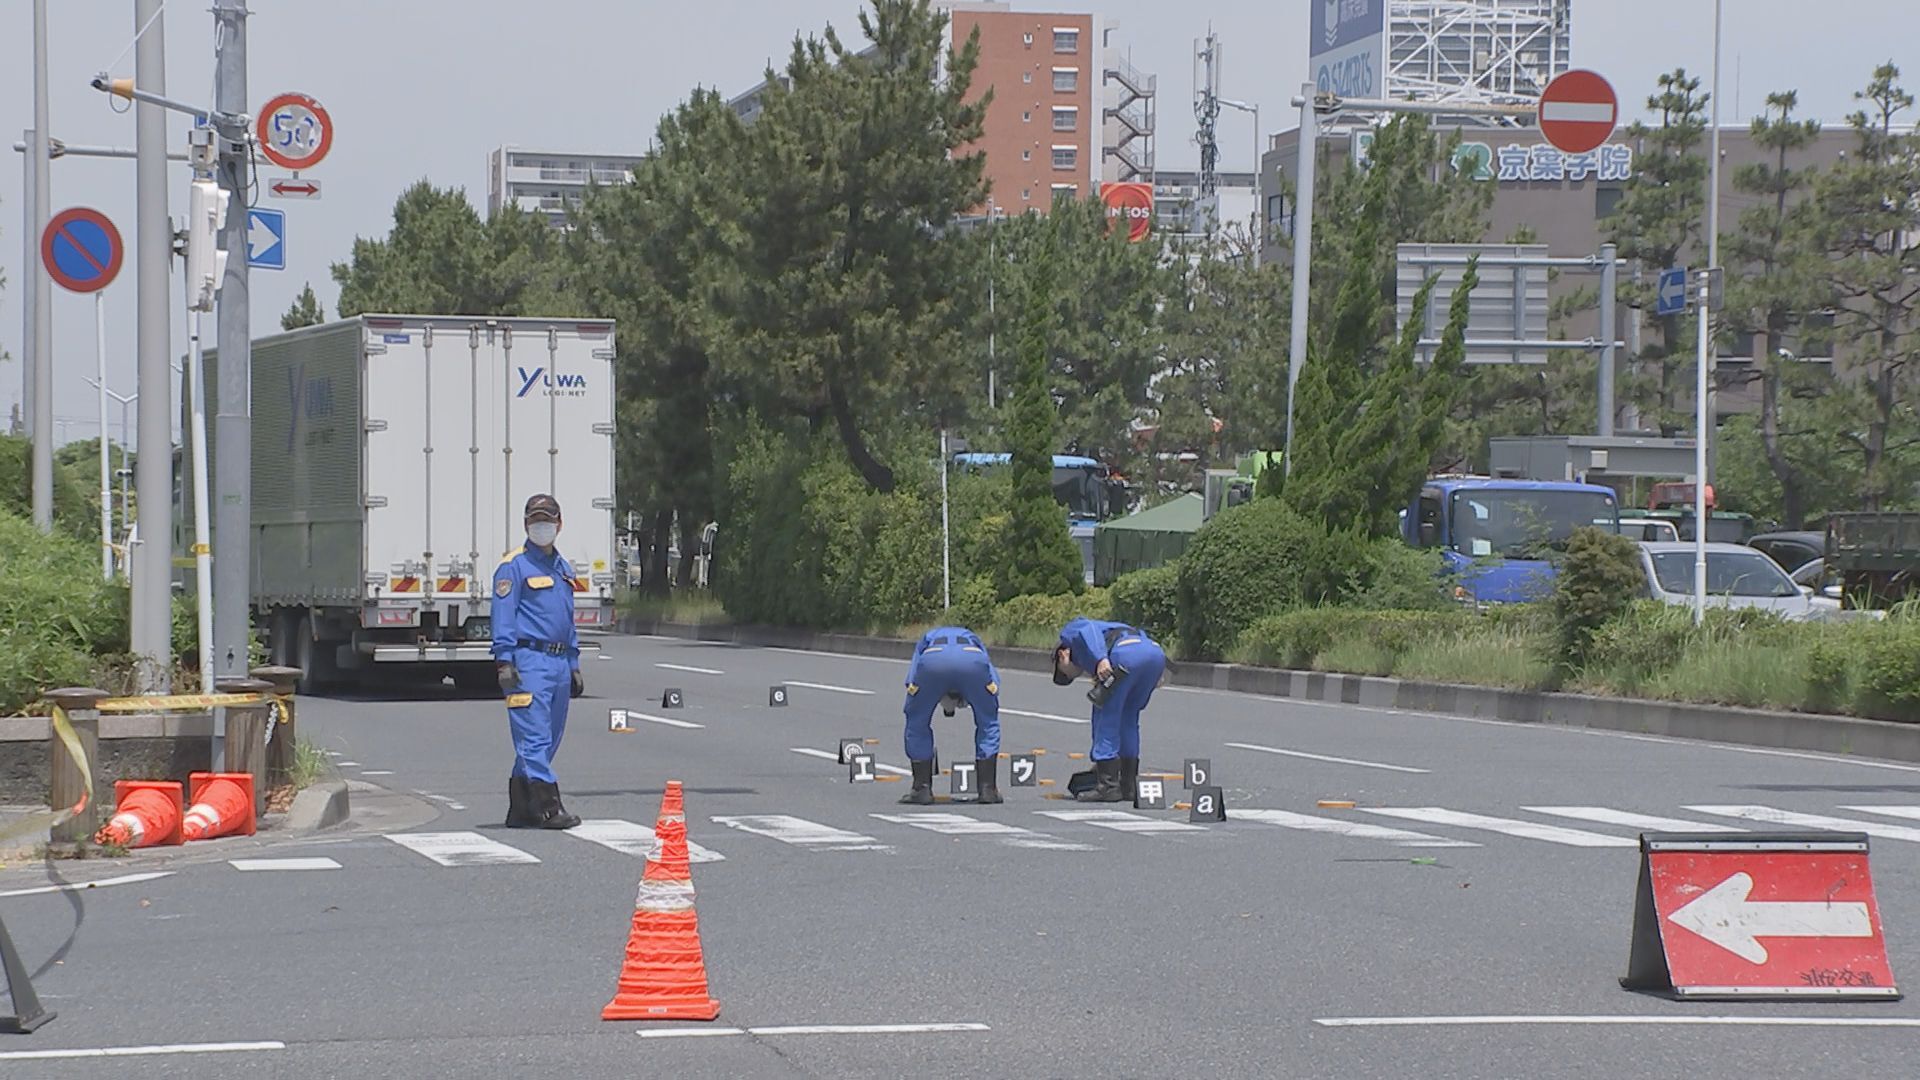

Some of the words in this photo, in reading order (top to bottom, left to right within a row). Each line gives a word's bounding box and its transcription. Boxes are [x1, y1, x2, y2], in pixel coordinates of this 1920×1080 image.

[274, 113, 314, 147] 50
[1498, 143, 1632, 180] 京葉学院
[516, 366, 587, 398] YUWA
[774, 690, 784, 702] e
[1013, 758, 1034, 782] ウ
[1190, 762, 1206, 785] b
[1139, 780, 1163, 804] 甲
[1197, 794, 1214, 814] a
